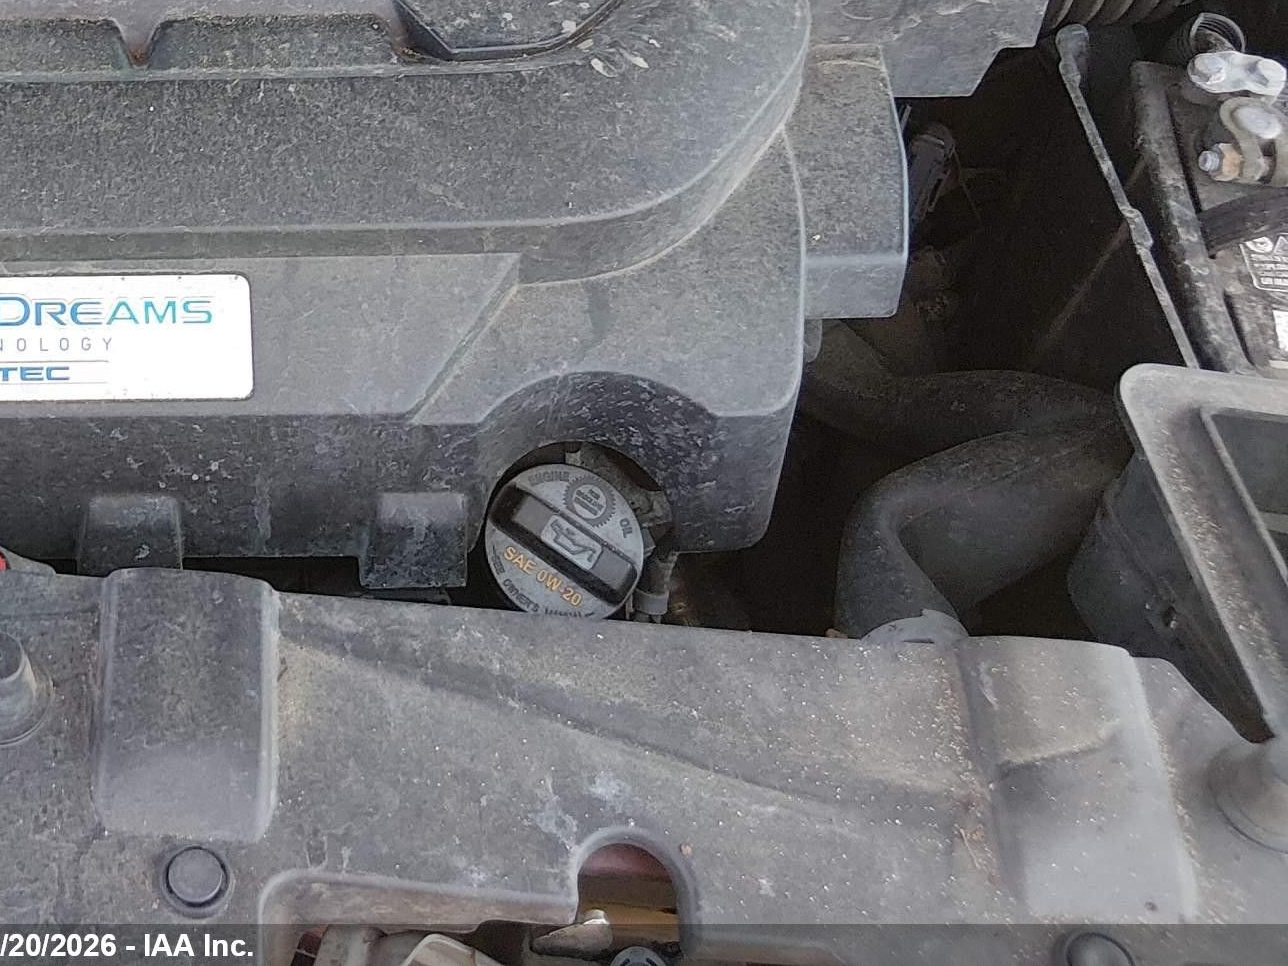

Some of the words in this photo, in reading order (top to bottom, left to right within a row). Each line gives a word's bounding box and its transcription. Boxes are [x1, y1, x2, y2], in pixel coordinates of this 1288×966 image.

[619, 517, 634, 539] OIL
[503, 545, 537, 575] SAE
[536, 569, 584, 608] 0W-20
